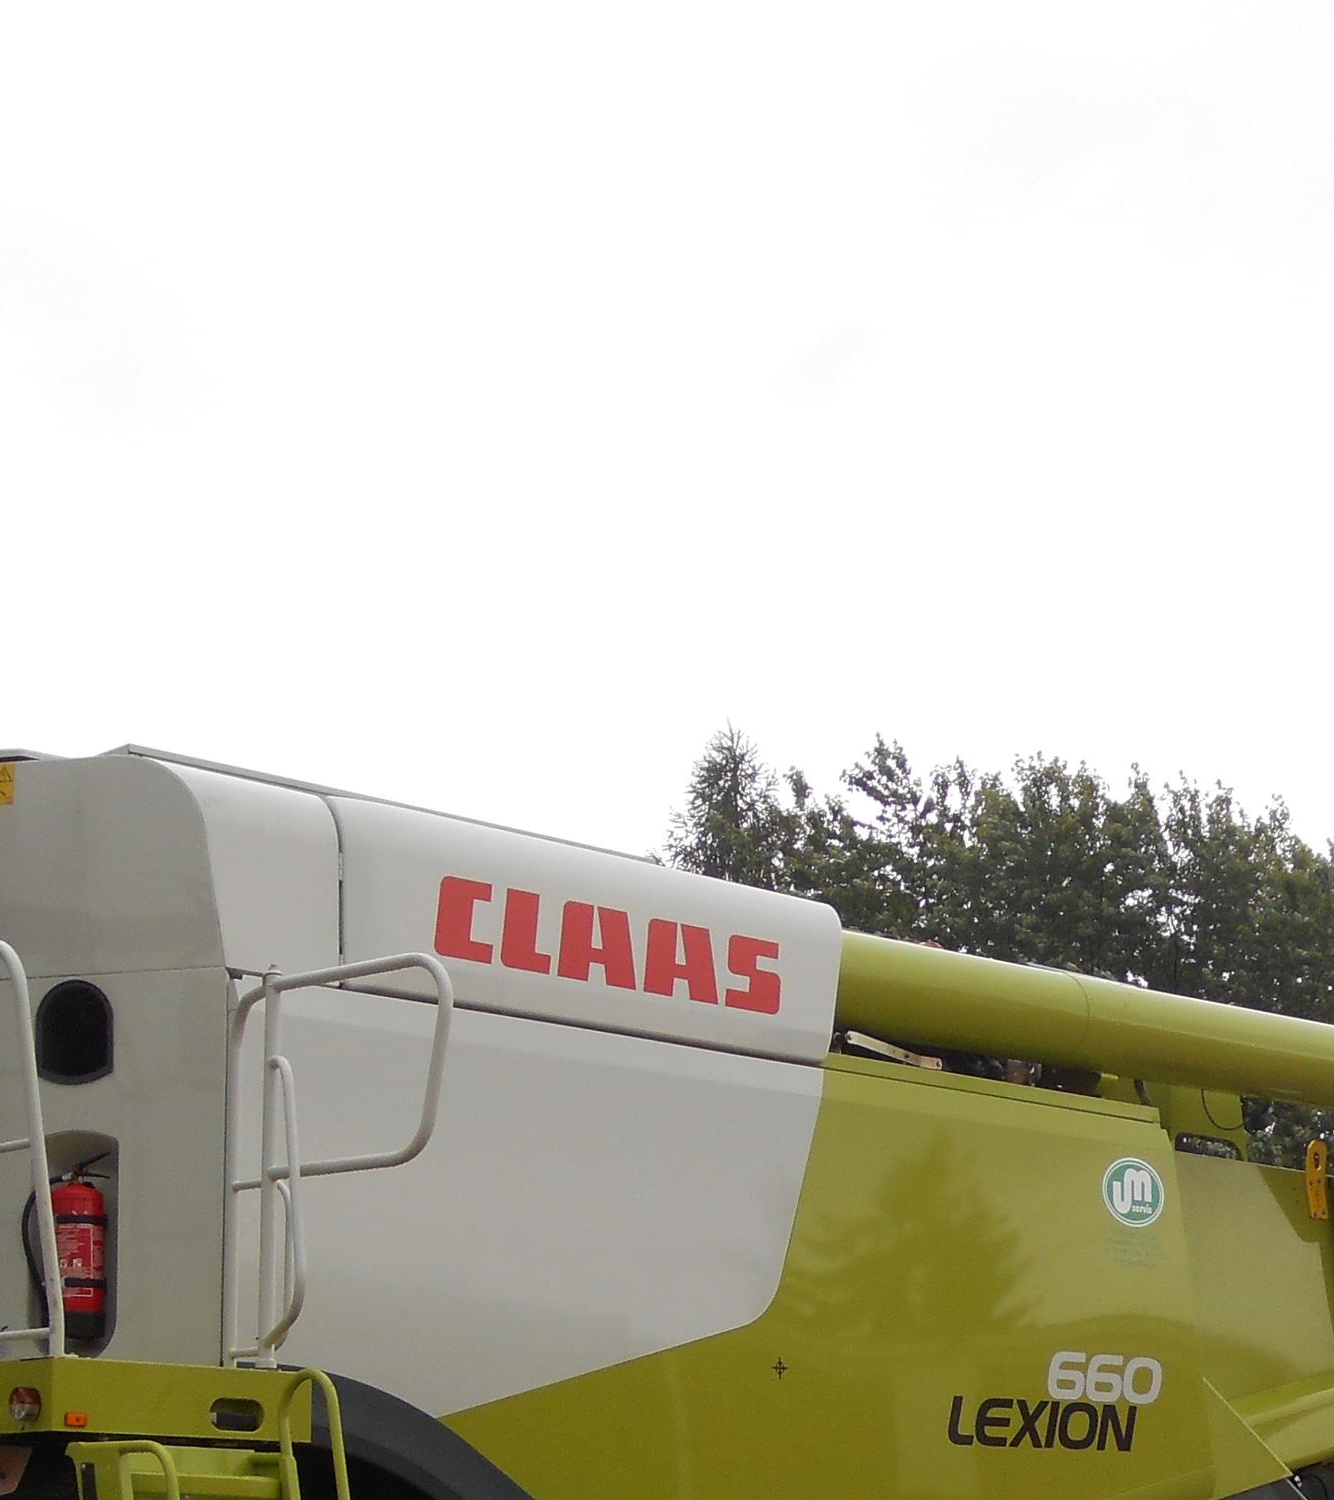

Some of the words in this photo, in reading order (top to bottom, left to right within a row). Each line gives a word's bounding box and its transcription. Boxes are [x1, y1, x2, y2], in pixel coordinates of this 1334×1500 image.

[434, 875, 781, 1015] CLAAS
[1047, 1351, 1163, 1404] 660
[948, 1395, 1137, 1452] LEXION
